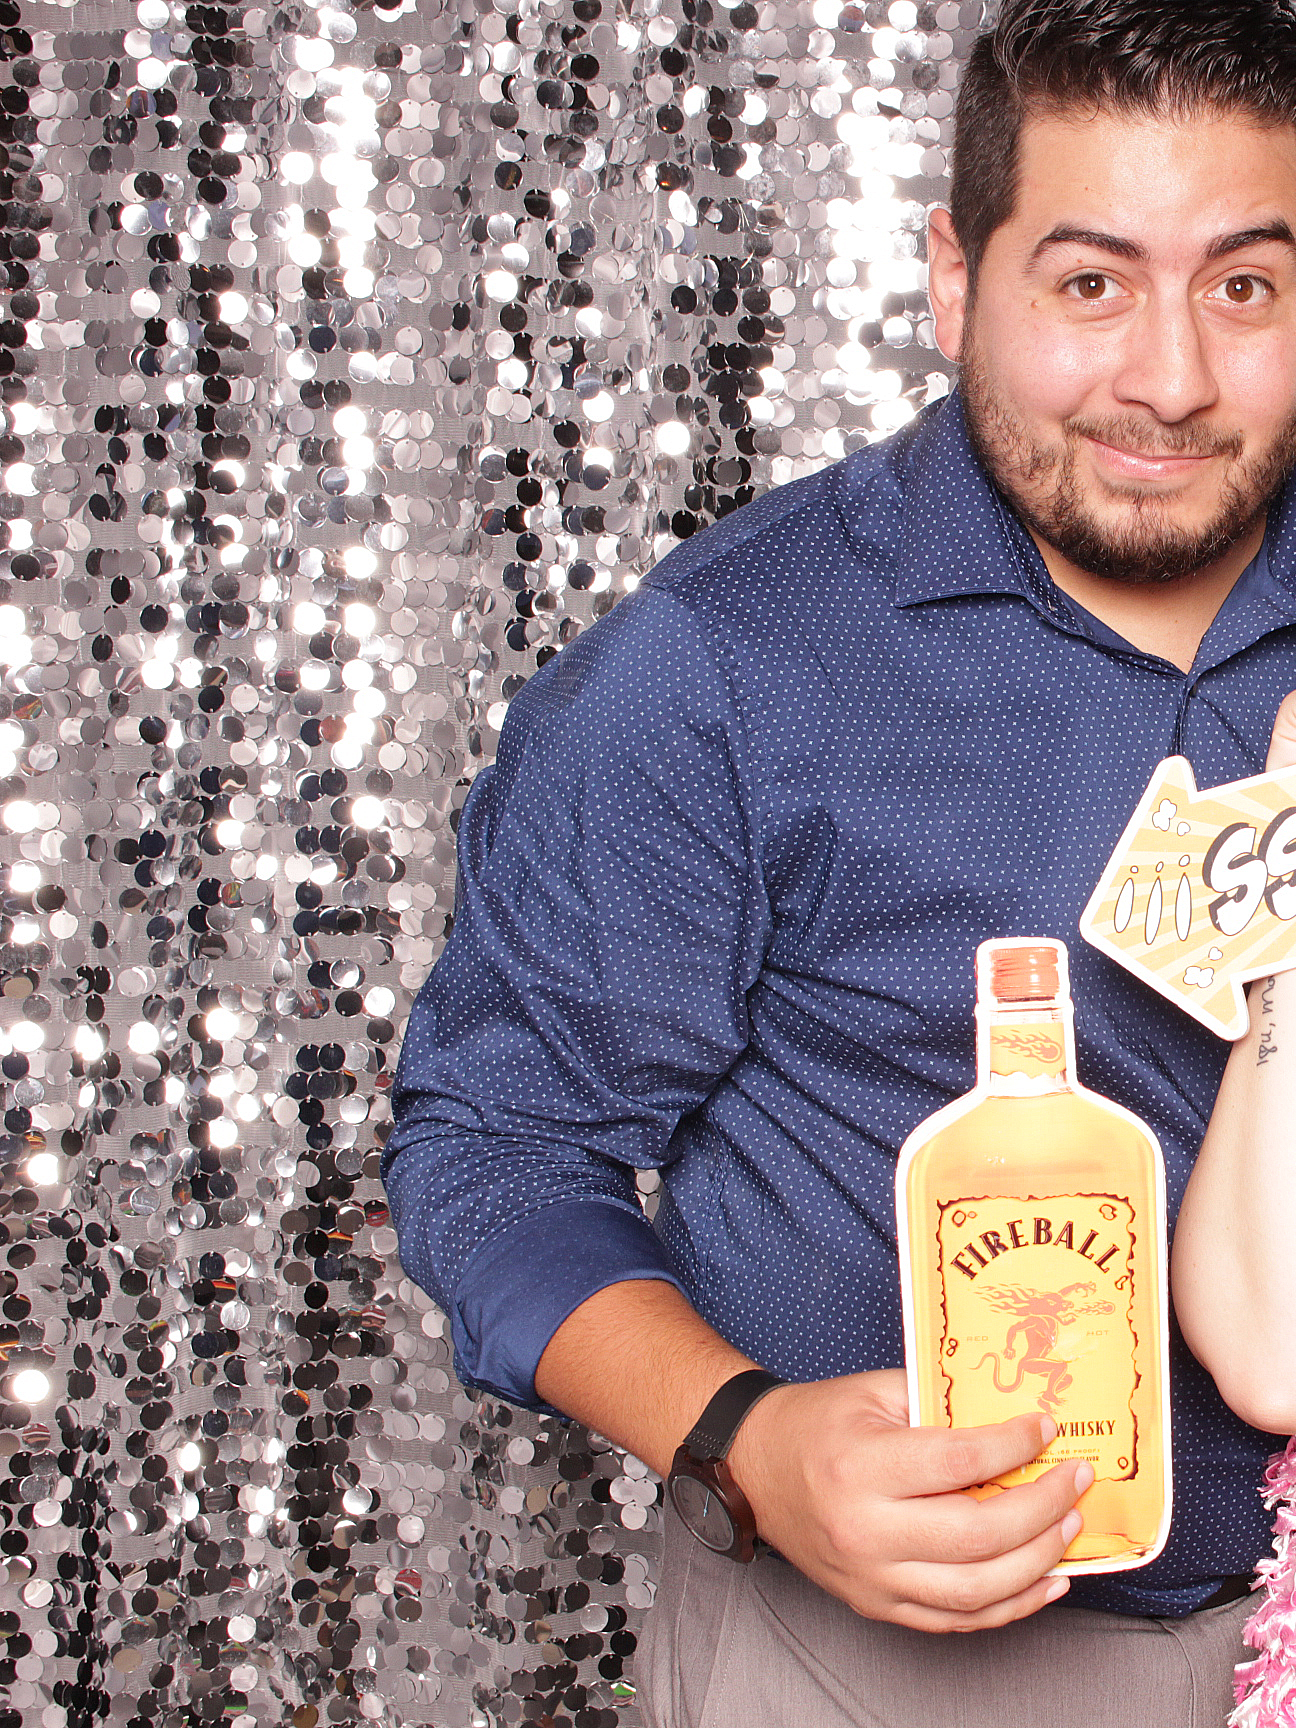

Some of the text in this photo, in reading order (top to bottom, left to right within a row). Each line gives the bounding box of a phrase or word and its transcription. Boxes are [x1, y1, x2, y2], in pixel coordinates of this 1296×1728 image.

[950, 1217, 1120, 1281] FIREBALL
[1086, 1329, 1111, 1337] HOT
[1056, 1420, 1116, 1438] WHISKY
